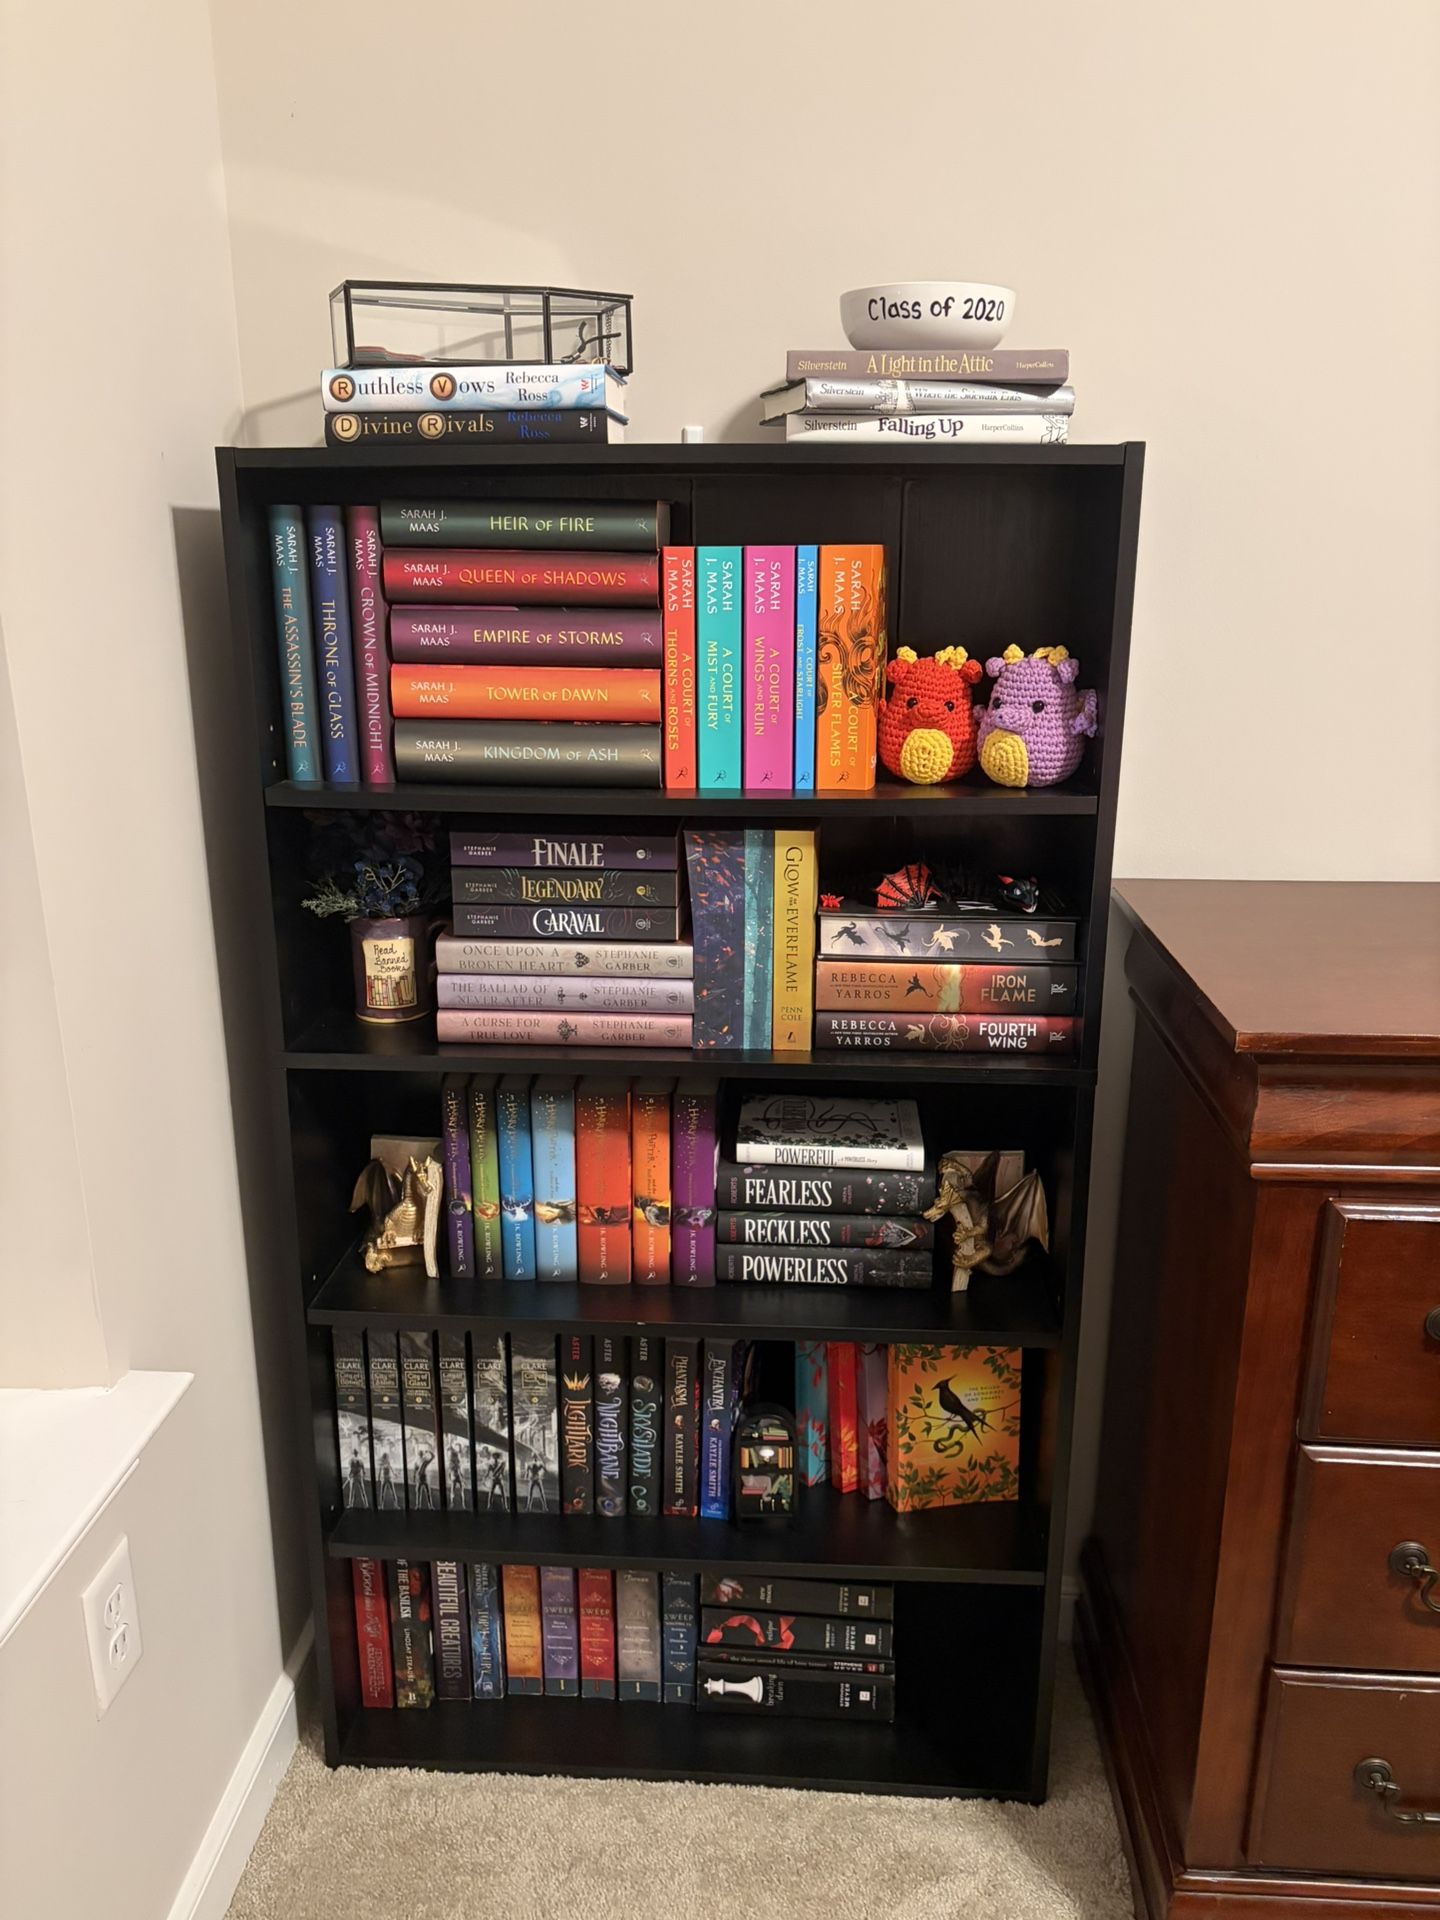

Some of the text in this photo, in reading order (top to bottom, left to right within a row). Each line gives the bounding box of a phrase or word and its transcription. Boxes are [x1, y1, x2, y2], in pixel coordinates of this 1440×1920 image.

[868, 297, 1004, 321] Class of 2020
[798, 353, 1054, 377] Silverstein A Light in the Attic HarperCollins
[505, 371, 558, 383] Rebecca
[329, 372, 495, 402] Ruthless Vows
[518, 388, 548, 401] Ross
[820, 383, 864, 396] Silverstein
[507, 411, 561, 423] Rebecca
[332, 413, 494, 442] Divine Rivals
[520, 425, 550, 440] Ross
[805, 418, 1023, 439] Silverstein Falling Up HarperCollins
[490, 517, 594, 532] HEIR OF FIRE
[459, 569, 626, 585] QUEEN OF SHADOWS
[474, 630, 624, 645] EMPIRE OF STORMS
[282, 587, 307, 748] THE ASSASSIN'S BLADE
[322, 600, 344, 739] THRONE OF GLASS
[360, 587, 383, 752] CROWN OF MIDNIGHT
[411, 682, 445, 690] SARAH
[682, 653, 692, 715] A COURT
[707, 640, 718, 730] MIST FURY
[722, 648, 733, 711] A COURT
[754, 636, 765, 736] WINGS RUIN
[769, 648, 780, 712] A COURT
[486, 687, 608, 701] TOWER OF DAWN
[668, 629, 678, 750] THORNS ROSES
[830, 663, 843, 767] SILVER FLAMES
[848, 705, 859, 753] COURT
[416, 741, 450, 750] SARAH
[484, 746, 618, 761] KINGDOM OF ASH
[425, 754, 454, 762] MAAS
[531, 839, 605, 866] FINALE
[784, 847, 803, 894] GLOW
[521, 876, 604, 902] LEGENDARY
[533, 909, 604, 935] CARAVAL
[374, 944, 397, 955] Read
[374, 953, 408, 965] Banned
[463, 946, 559, 957] ONCE UPON A
[595, 950, 659, 960] STEPHANIE
[786, 908, 799, 992] EVERFLAME
[378, 965, 410, 973] Books
[459, 960, 565, 971] BROKEN HEART
[606, 962, 650, 971] GARBER
[831, 972, 896, 983] REBECCA
[992, 975, 1027, 987] IRON
[451, 983, 548, 994] THE BALLAD OF
[593, 986, 656, 996] STEPHANIE
[836, 989, 891, 1000] YARROS
[981, 988, 1036, 1002] FLAME
[502, 997, 544, 1006] AFTER
[603, 999, 647, 1007] GARBER
[462, 1018, 540, 1028] A CURSE FOR
[593, 1021, 654, 1030] STEPHANIE
[831, 1020, 896, 1031] REBECCA
[979, 1023, 1036, 1036] FOURTH
[469, 1031, 533, 1040] TRUE LOVE
[602, 1033, 645, 1041] GARBER
[836, 1036, 891, 1046] YARROS
[988, 1037, 1027, 1049] WING
[774, 1147, 836, 1166] POWERFUL
[745, 1178, 832, 1207] FEARLESS
[745, 1219, 831, 1245] RECKLESS
[742, 1255, 848, 1284] POWERLESS
[570, 1337, 580, 1360] ASTER
[603, 1338, 612, 1362] ASTER
[639, 1337, 648, 1361] ASTER
[440, 1361, 464, 1369] CLARE
[671, 1355, 688, 1409] PHANTASMA
[707, 1352, 726, 1413] ENCHANTRA
[564, 1398, 592, 1473] LIGHTLARK
[596, 1397, 624, 1480] NIGHTBANE
[631, 1399, 656, 1478] SKYSHADE
[708, 1438, 717, 1468] KAYLIE
[675, 1434, 684, 1494] KAYLIE SMITH
[708, 1470, 718, 1497] SMITH
[398, 1569, 412, 1619] THE BASILISK
[437, 1561, 462, 1679] BEAUTIFUL CREATURES
[664, 1613, 694, 1621] SWEEP
[767, 1674, 777, 1706] breaking
